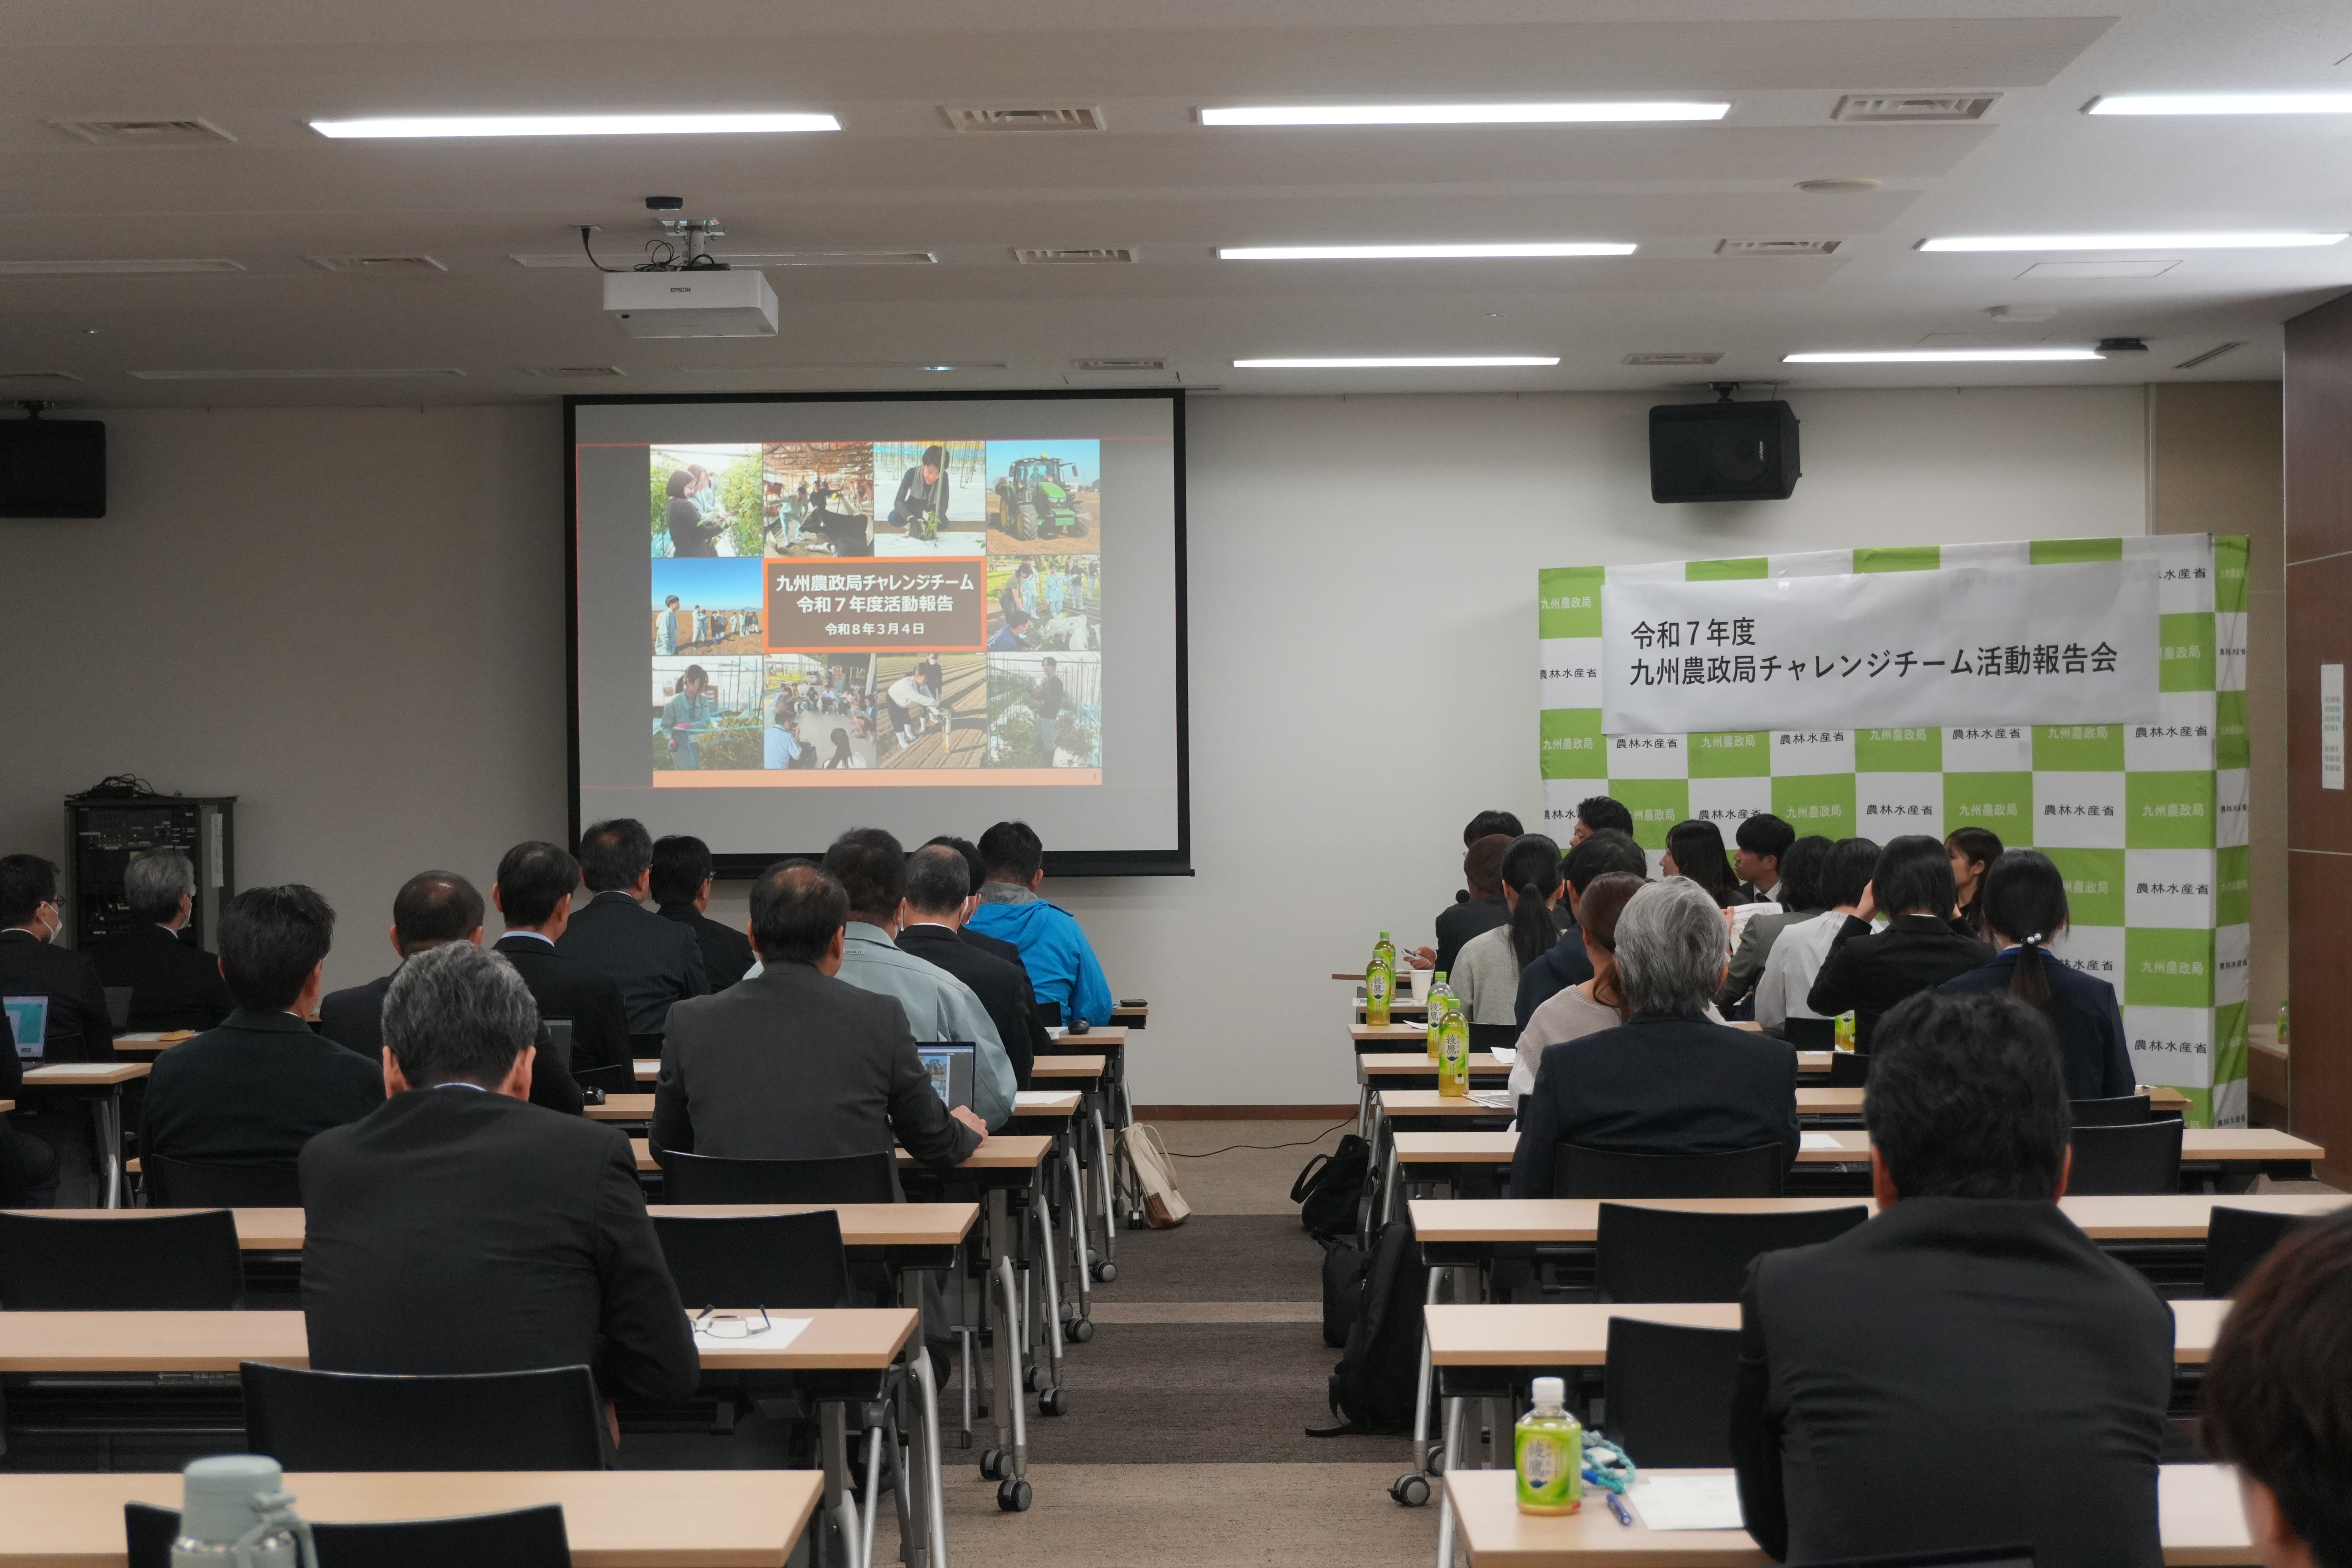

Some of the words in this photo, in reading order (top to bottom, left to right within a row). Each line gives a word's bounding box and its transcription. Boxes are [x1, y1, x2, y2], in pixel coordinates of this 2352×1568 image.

[2159, 567, 2206, 580] 水産省
[776, 574, 974, 591] 九州農政局チャレンジチーム
[797, 595, 953, 613] 令和7年度活動報告
[1540, 596, 1591, 609] 九州農政局
[825, 623, 923, 635] 令和8年3月4日
[1631, 617, 1755, 649] 令和7年度
[2160, 646, 2200, 660] 農政局
[1630, 641, 2117, 686] 九州農政局チャレンジチーム活動報告会
[1540, 669, 1596, 679] 農林水産省
[1780, 732, 1843, 744] 農林水産省
[1871, 729, 1926, 740] 九州農政局
[1953, 728, 2020, 739] 農林水産省
[2049, 727, 2107, 739] 九州農政局
[2136, 726, 2207, 738] 農林水産省
[1543, 738, 1593, 749] 九州農政局
[1617, 738, 1677, 748] 農林水産省
[1702, 735, 1755, 747] 九州農政局
[1544, 809, 1580, 820] 農林水
[1632, 809, 1675, 821] 州農政局
[1787, 805, 1841, 818] 九州農政局
[1867, 804, 1932, 816] 農林水産省
[1960, 804, 2017, 816] 九州農政局
[2044, 805, 2113, 816] 農林水産省
[2143, 804, 2203, 817] 九州農政局
[2063, 880, 2108, 894] 州農政局
[2137, 883, 2208, 894] 農林水産省
[2060, 958, 2113, 971] 林水産省
[2142, 961, 2203, 975] 九州農政局
[1373, 975, 1382, 994] 綾鷹
[1429, 1001, 1438, 1021] 綾鷹
[1446, 1034, 1457, 1055] 綾鷹
[2135, 1040, 2206, 1054] 農林水産省
